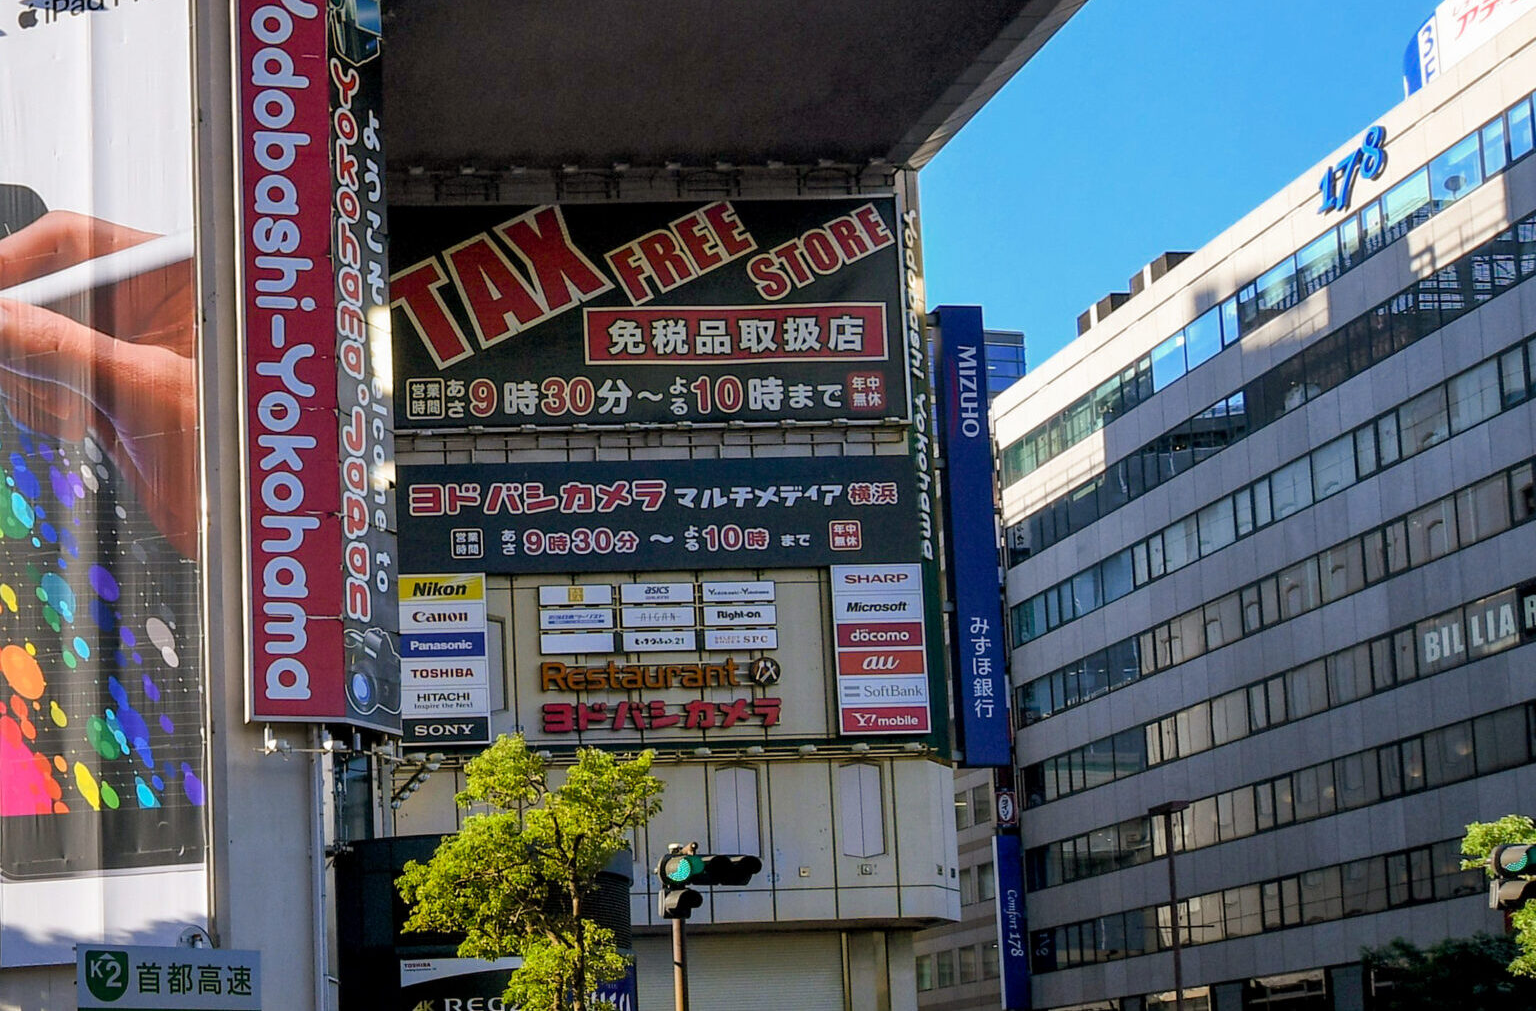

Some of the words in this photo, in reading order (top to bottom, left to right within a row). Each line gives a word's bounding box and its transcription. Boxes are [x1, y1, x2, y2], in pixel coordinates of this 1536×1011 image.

[1317, 125, 1388, 215] 178
[389, 203, 616, 371] TAX
[604, 199, 759, 307] FREE
[747, 202, 896, 301] STORE
[607, 315, 864, 355] 免税品取扱店
[957, 345, 980, 439] MIZUHO
[370, 344, 389, 532] elcome
[914, 393, 934, 561] Yokohama
[409, 479, 667, 517] ヨドバシカメラ
[376, 552, 391, 593] to
[844, 573, 909, 584] SHARP
[412, 582, 468, 597] Nikon
[412, 611, 469, 623] Canon
[716, 610, 762, 621] Right-on
[846, 601, 908, 613] Microsoft
[410, 639, 473, 651] Panasonic
[410, 667, 474, 679] TOSHIBA
[540, 657, 741, 692] Restaurant
[862, 655, 901, 670] au
[970, 616, 995, 718] みずほ銀行
[416, 692, 470, 702] HITACHI
[864, 684, 924, 698] SoftBank
[414, 702, 440, 710] Inspire
[542, 697, 782, 733] ヨドバシカメラ
[414, 724, 475, 736] SONY
[1004, 889, 1022, 929] Comfort
[1008, 932, 1024, 957] 178
[136, 962, 252, 996] 首都高速
[444, 997, 521, 1011] REG
